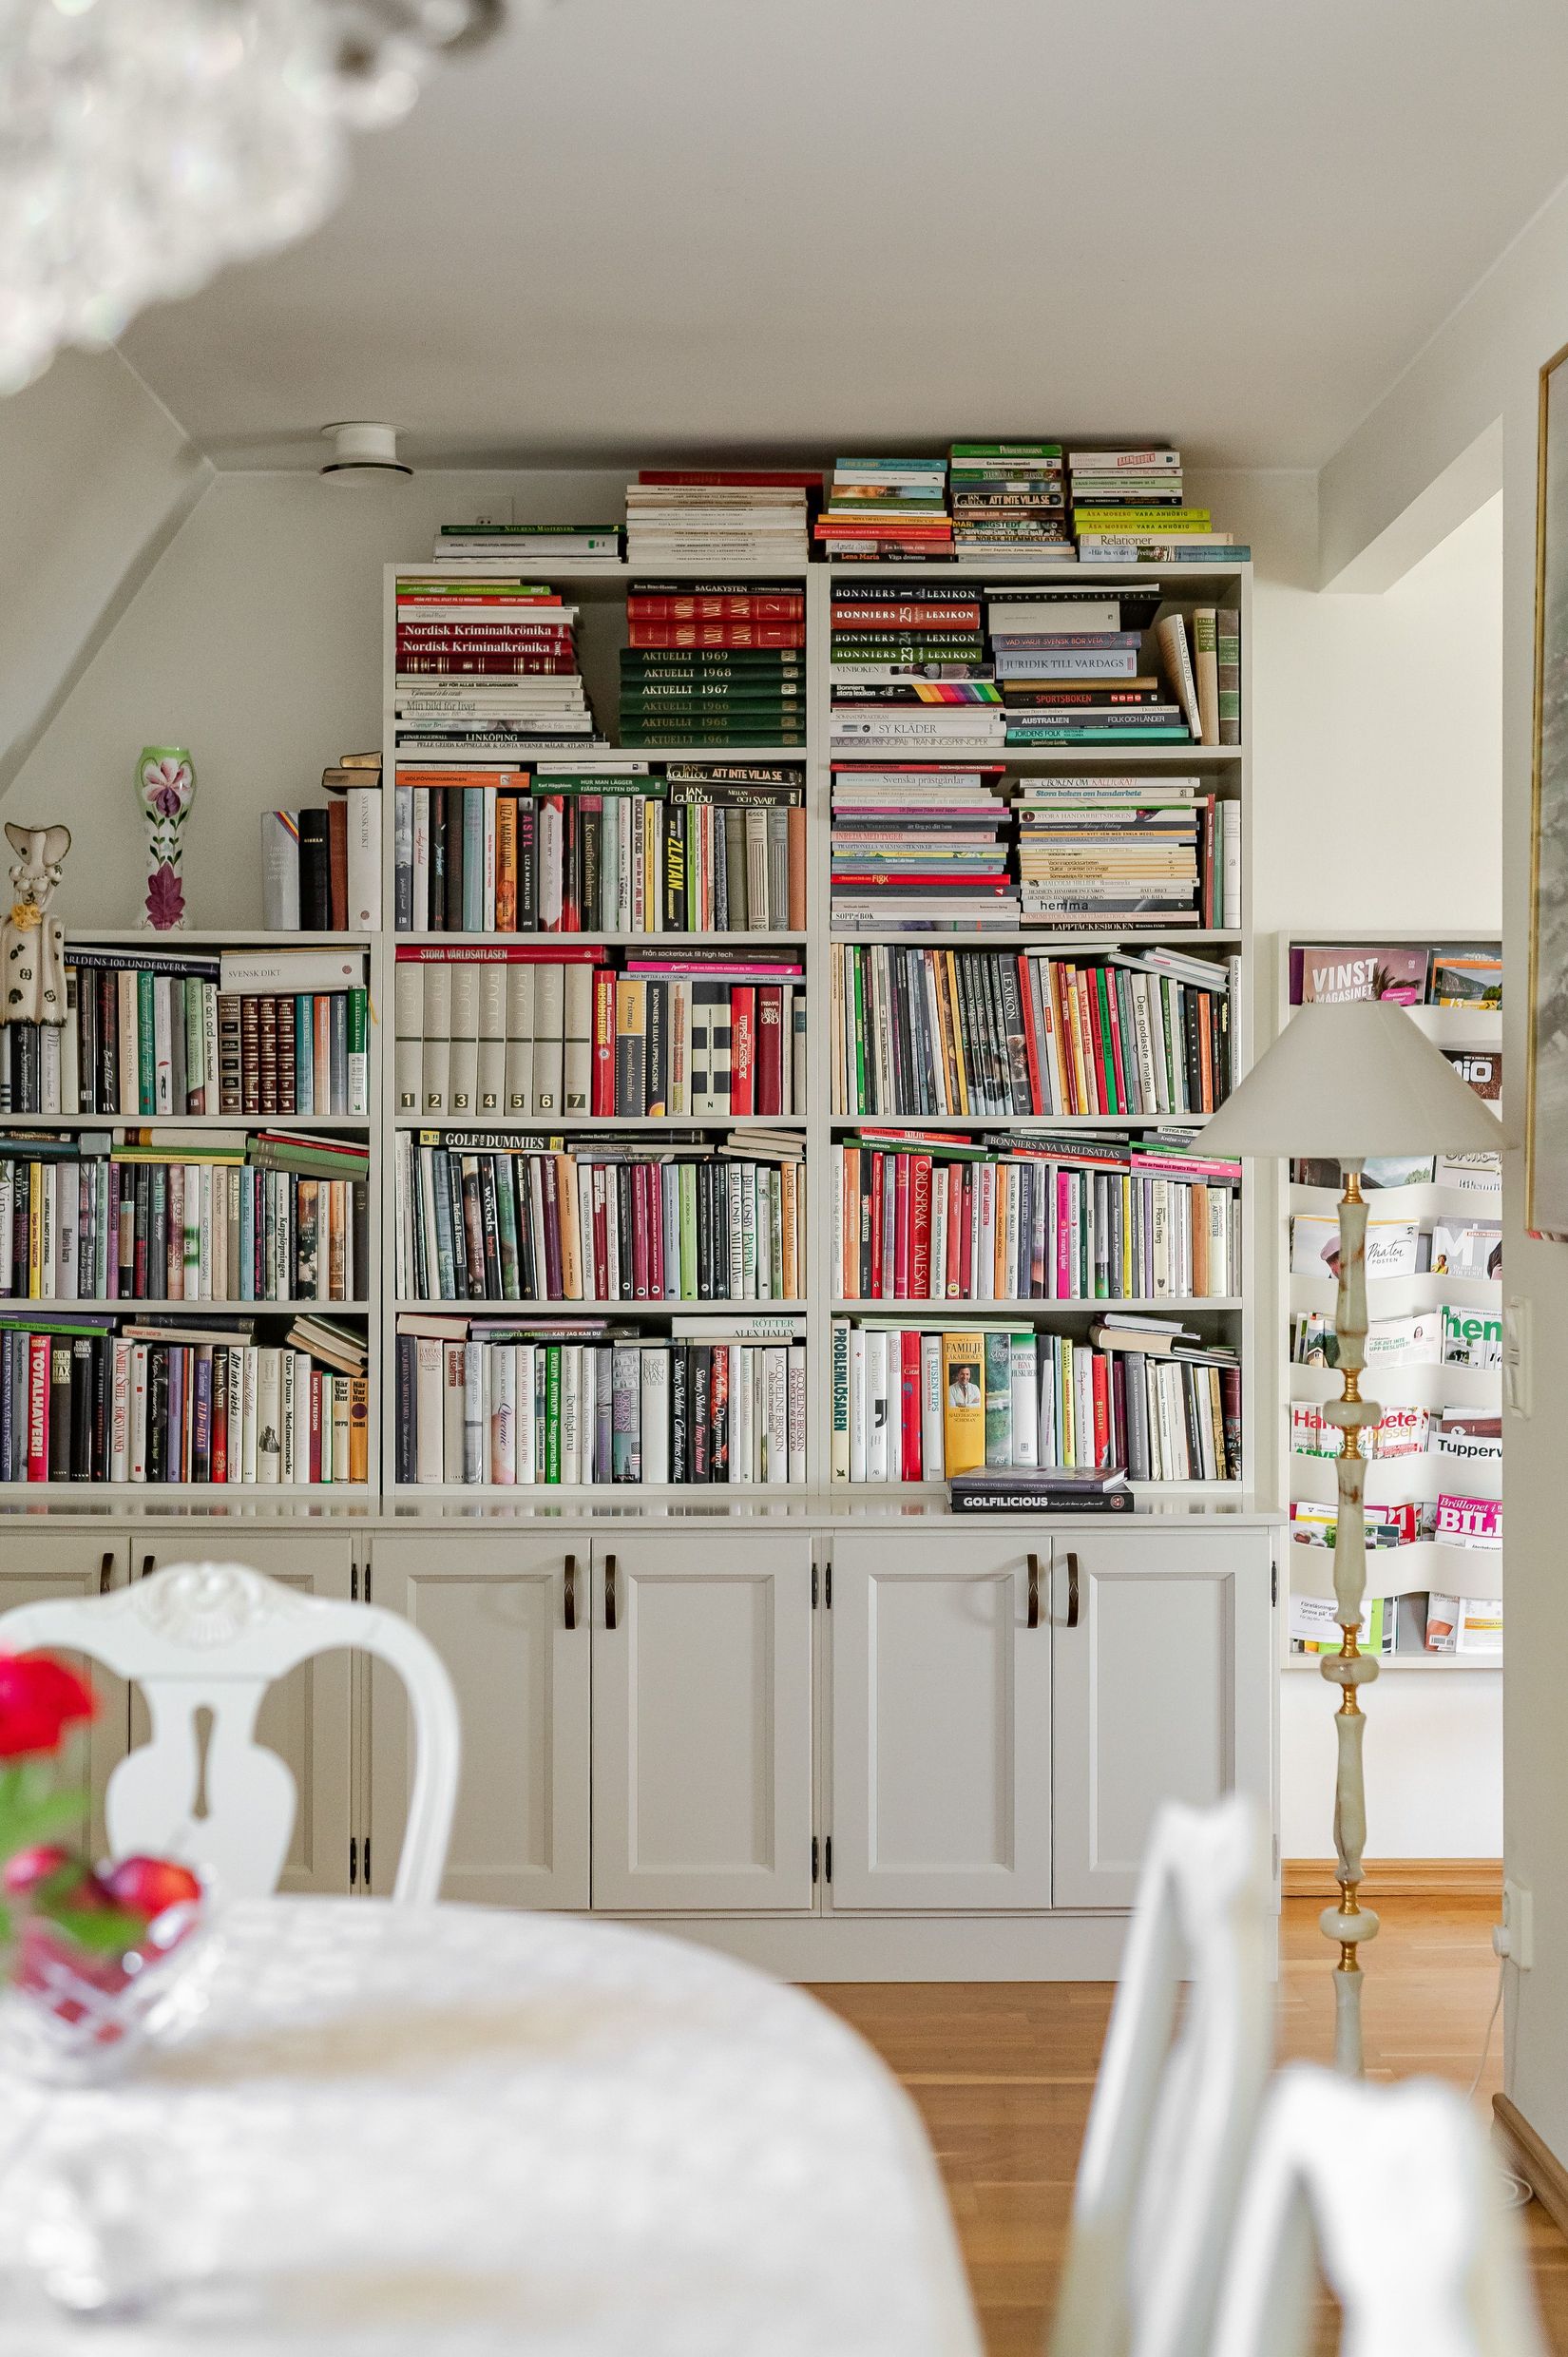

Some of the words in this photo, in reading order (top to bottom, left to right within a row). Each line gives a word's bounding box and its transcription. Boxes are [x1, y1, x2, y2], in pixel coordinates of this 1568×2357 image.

[1100, 534, 1152, 546] Relationer
[836, 589, 896, 598] BONNIERS
[927, 589, 976, 599] LEXIKON
[836, 610, 896, 619] BONNIERS
[926, 610, 974, 619] LEXIKON
[405, 624, 450, 636] Nordisk
[454, 623, 552, 636] Kriminalkrönika
[403, 641, 449, 652] Nordisk
[452, 641, 550, 653] Kriminalkrönika
[642, 652, 694, 661] AKTUELLT
[701, 651, 729, 661] 1969
[837, 650, 897, 659] BONNIERS
[927, 650, 977, 659] LEXIKON
[1004, 660, 1047, 671] JURIDIK
[1050, 660, 1073, 669] TILL
[1075, 659, 1124, 669] VARDAGS
[644, 669, 695, 678] AKTUELLT
[702, 667, 732, 678] 1968
[642, 684, 693, 695] AKTUELLT
[701, 684, 729, 695] 1967
[466, 732, 518, 742] LINKÖPING
[523, 814, 533, 848] ASYL
[583, 823, 596, 908] Konstförfalskning
[1040, 900, 1089, 910] hemma
[64, 956, 108, 967] RLDENS
[1312, 957, 1378, 992] VINST
[1003, 971, 1017, 1021] LEXIKON
[1137, 996, 1146, 1016] Den
[206, 1021, 216, 1038] ord
[1138, 1019, 1150, 1059] godaste
[1143, 1063, 1153, 1093] maten
[430, 1095, 441, 1107] 2
[456, 1095, 467, 1107] 3
[484, 1095, 495, 1107] 4
[513, 1095, 523, 1107] 5
[542, 1095, 551, 1107] 6
[572, 1095, 582, 1107] 7
[445, 1133, 480, 1146] GOLF
[486, 1135, 545, 1150] DUMMIES
[694, 1369, 706, 1393] Sidney
[833, 1329, 849, 1431] PROBLEMLÖSAREN
[30, 1350, 46, 1457] TOTALHAVERI!
[550, 1380, 559, 1416] ANTHONY
[675, 1384, 685, 1416] Sheldon
[696, 1393, 706, 1423] Sheldon
[964, 1497, 1048, 1507] GOLFILICIOUS
[1439, 1497, 1489, 1512] Bröllopet
